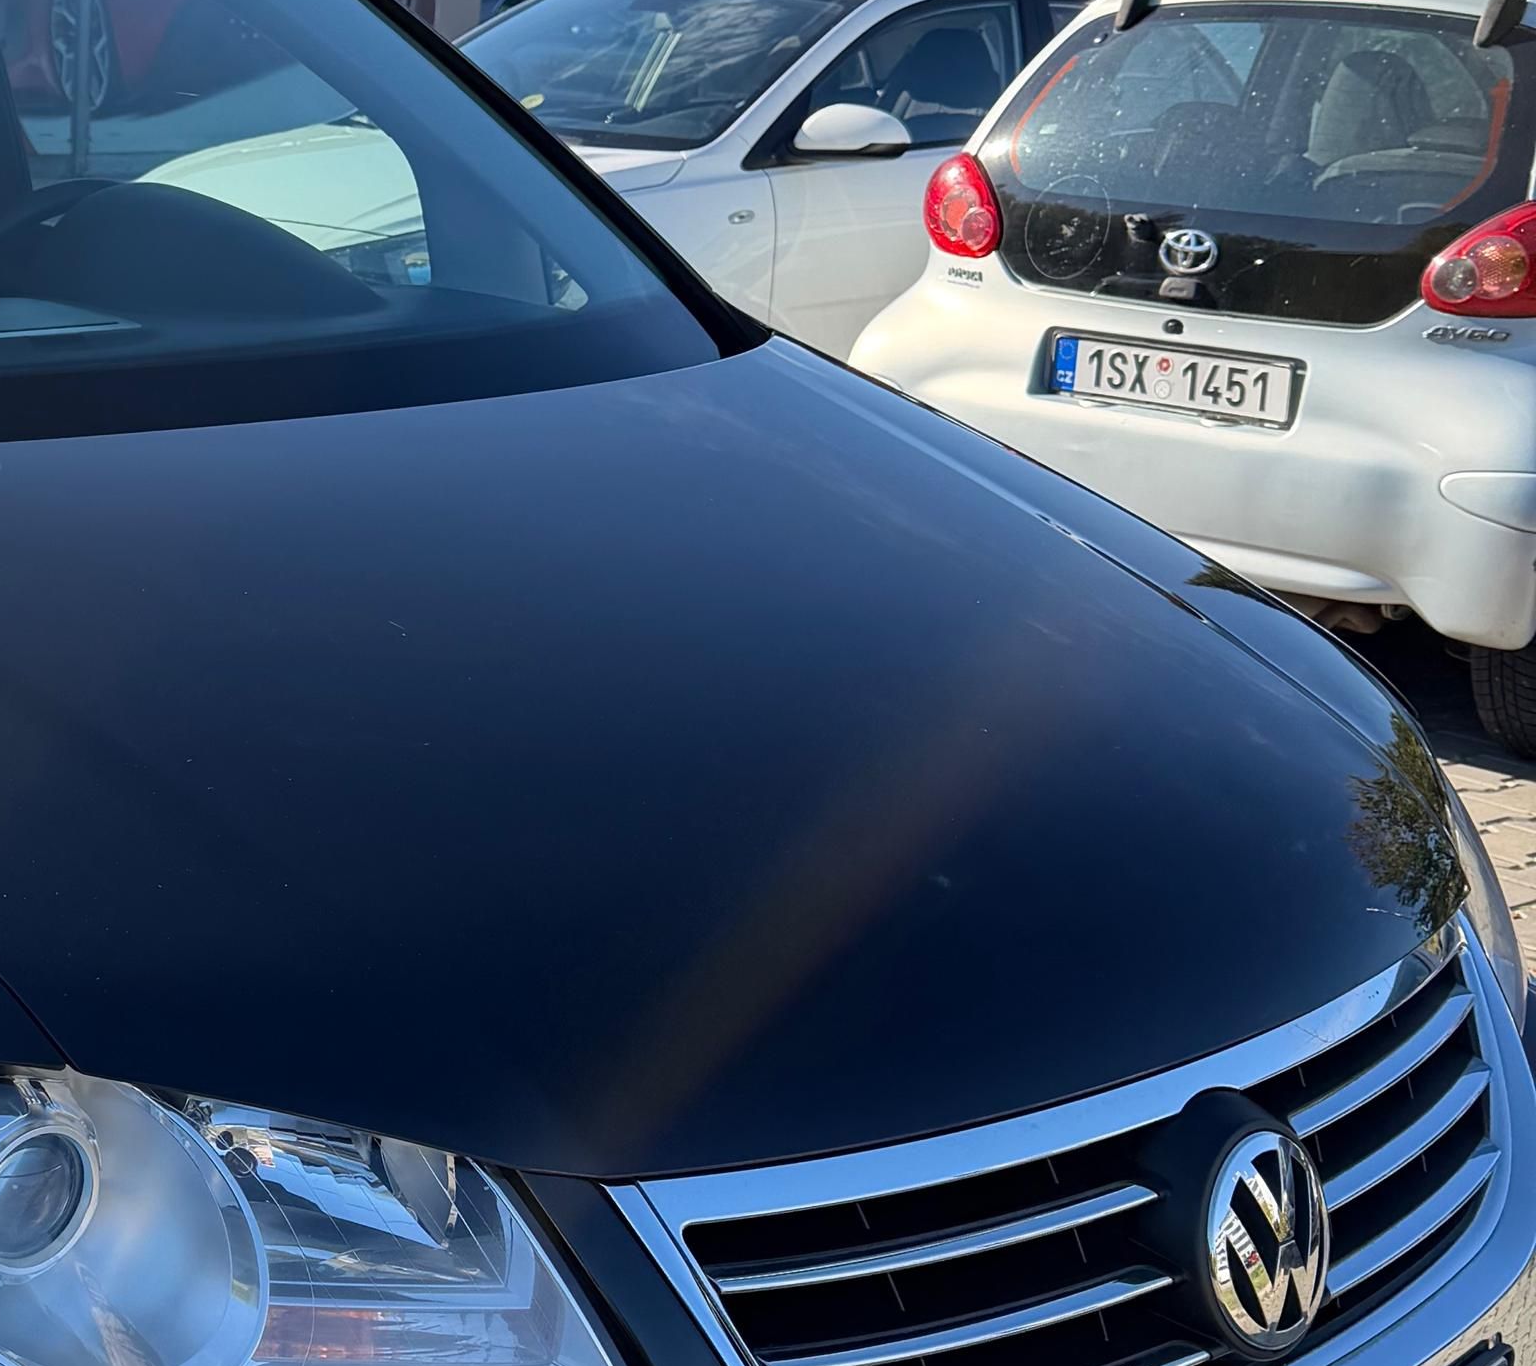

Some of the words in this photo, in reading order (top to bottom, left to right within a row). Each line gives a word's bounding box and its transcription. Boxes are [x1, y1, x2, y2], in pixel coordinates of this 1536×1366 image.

[1056, 370, 1074, 384] CZ
[1088, 349, 1150, 395] 1SX
[1182, 362, 1270, 412] 1451
